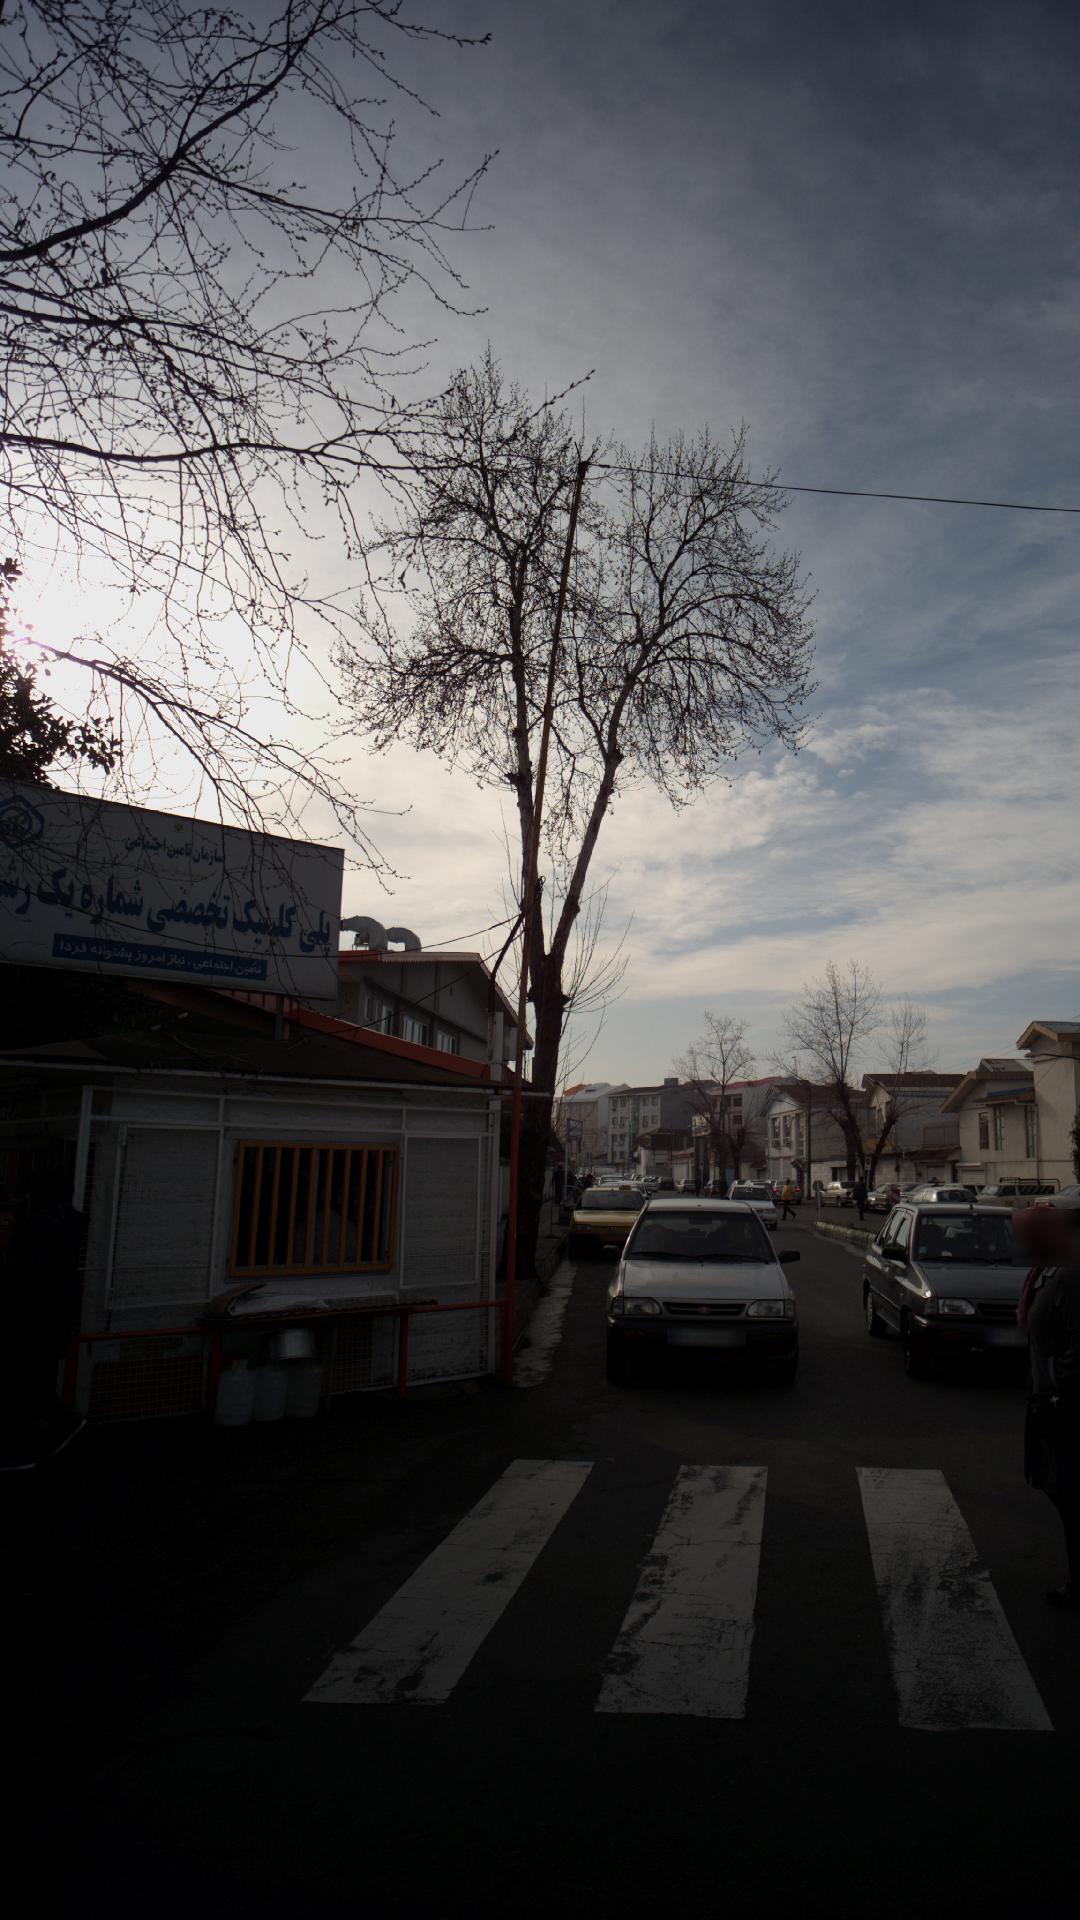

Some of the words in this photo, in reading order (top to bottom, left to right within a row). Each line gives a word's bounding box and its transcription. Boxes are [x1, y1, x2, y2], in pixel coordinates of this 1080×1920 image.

[193, 845, 224, 866] سازمان
[0, 857, 31, 914] رش
[37, 863, 74, 919] یک
[80, 875, 144, 924] شماره
[147, 894, 229, 932] تخصصی
[59, 939, 88, 955] فردا
[299, 910, 331, 960] پلی
[134, 950, 166, 964] امروز
[166, 953, 186, 967] نیاز
